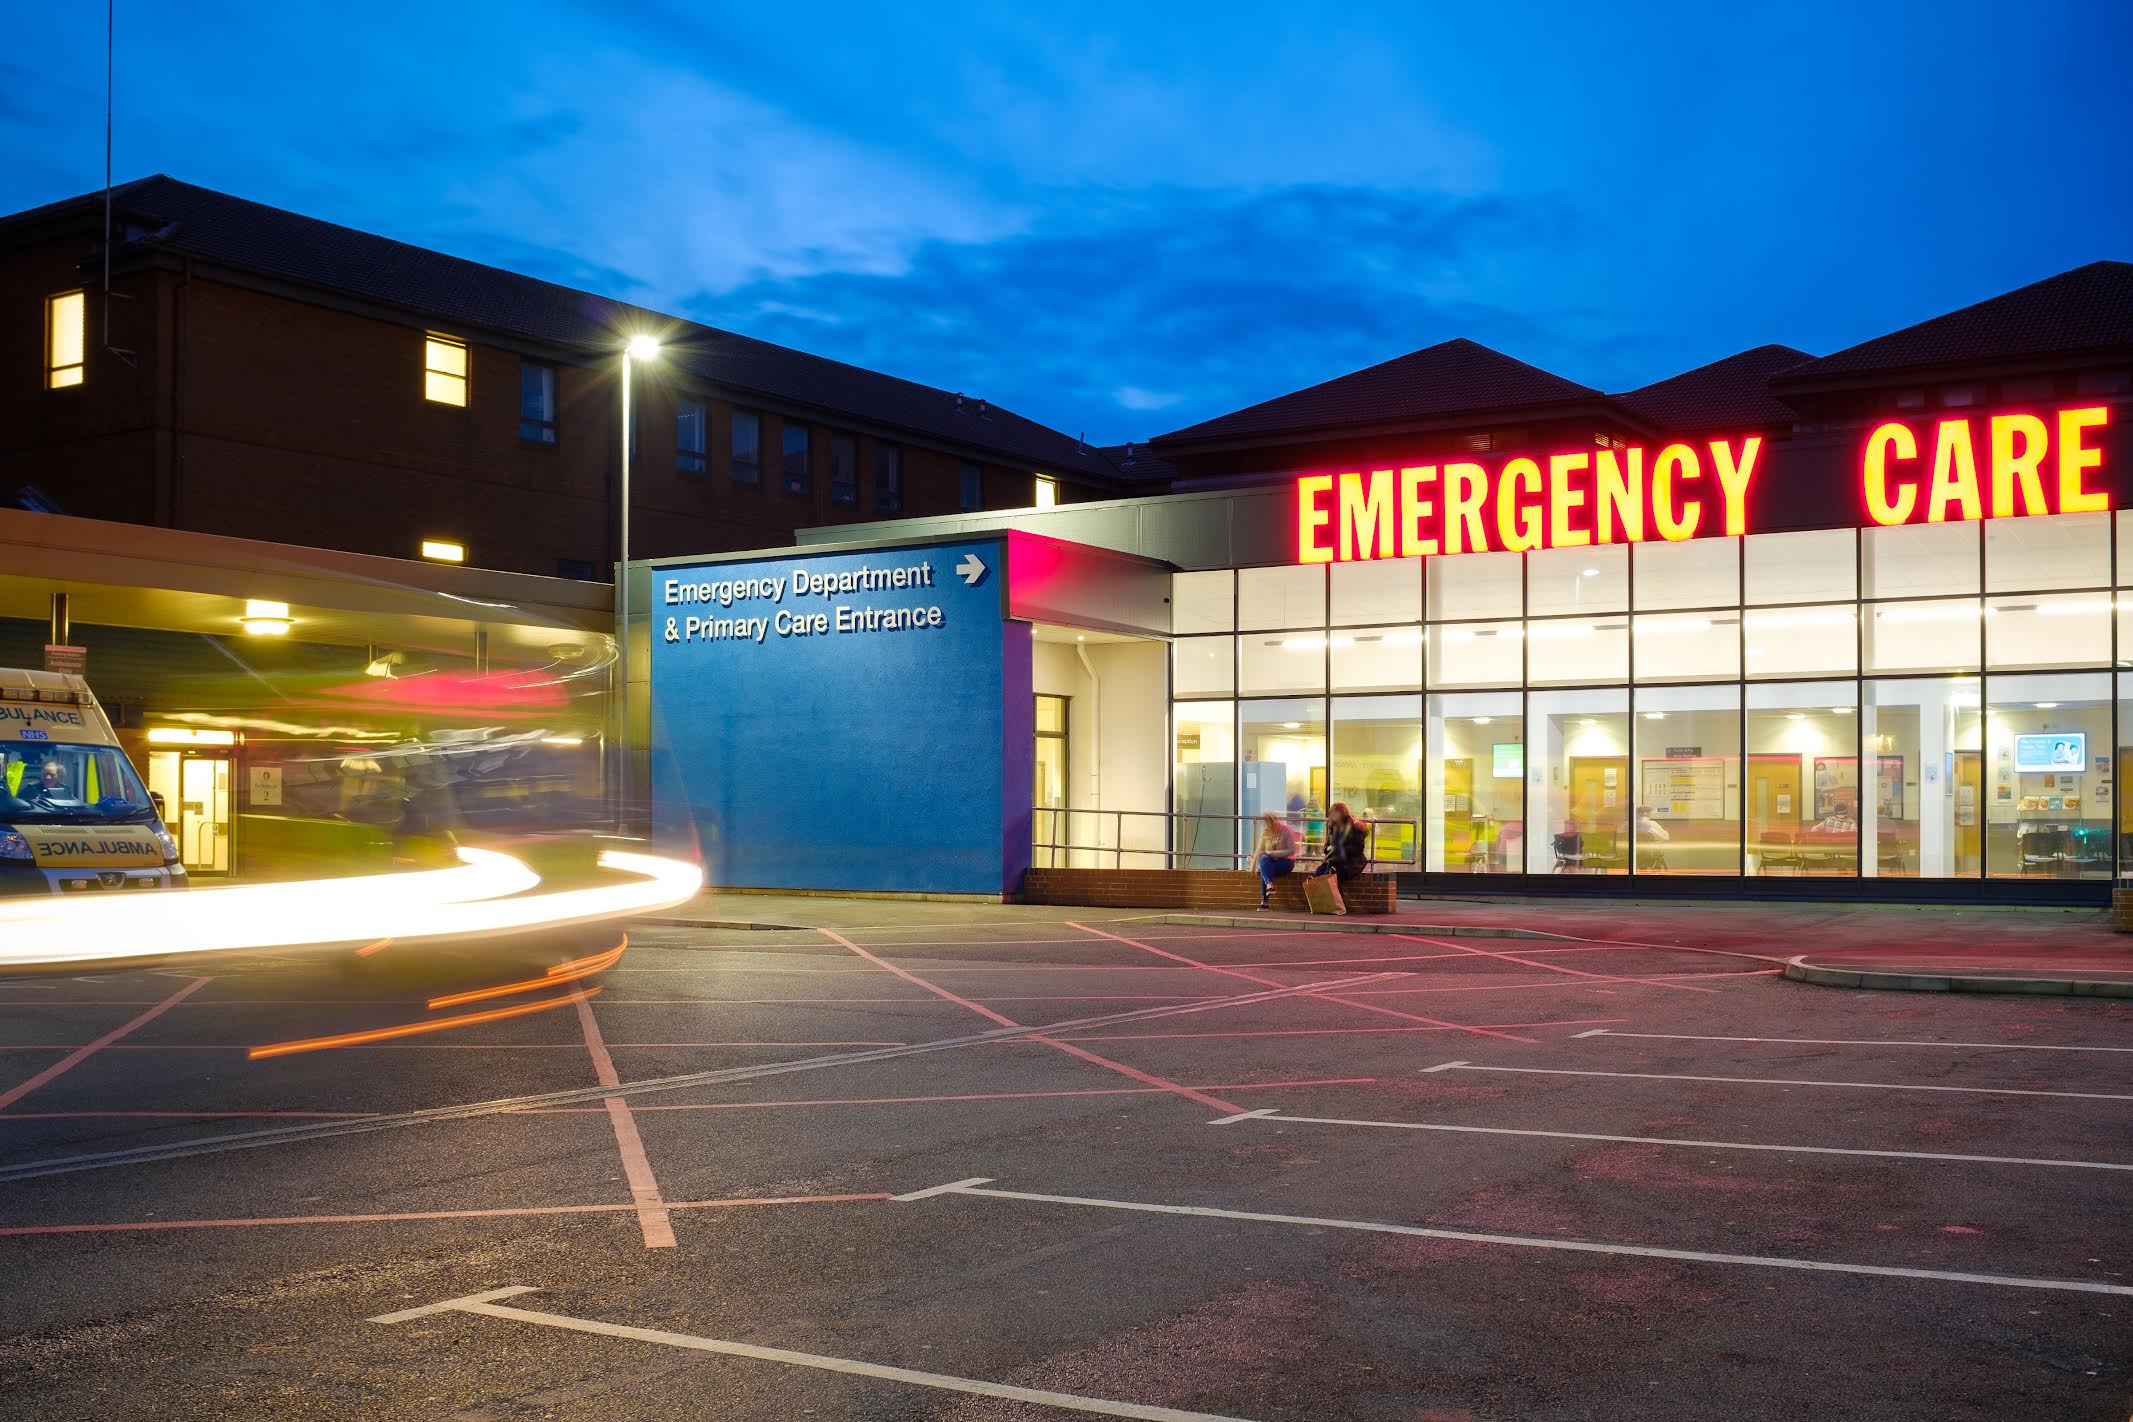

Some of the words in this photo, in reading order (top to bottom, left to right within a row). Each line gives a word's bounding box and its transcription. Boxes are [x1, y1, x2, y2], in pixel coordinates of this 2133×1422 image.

[1296, 435, 1763, 566] EMERGENCY
[1862, 405, 2110, 526] CARE
[665, 576, 785, 606] Emergency
[792, 561, 931, 598] Department
[664, 617, 679, 641] &
[686, 614, 768, 642] Primary
[775, 609, 828, 636] Care
[835, 604, 942, 632] Entrance
[21, 730, 47, 739] NHS
